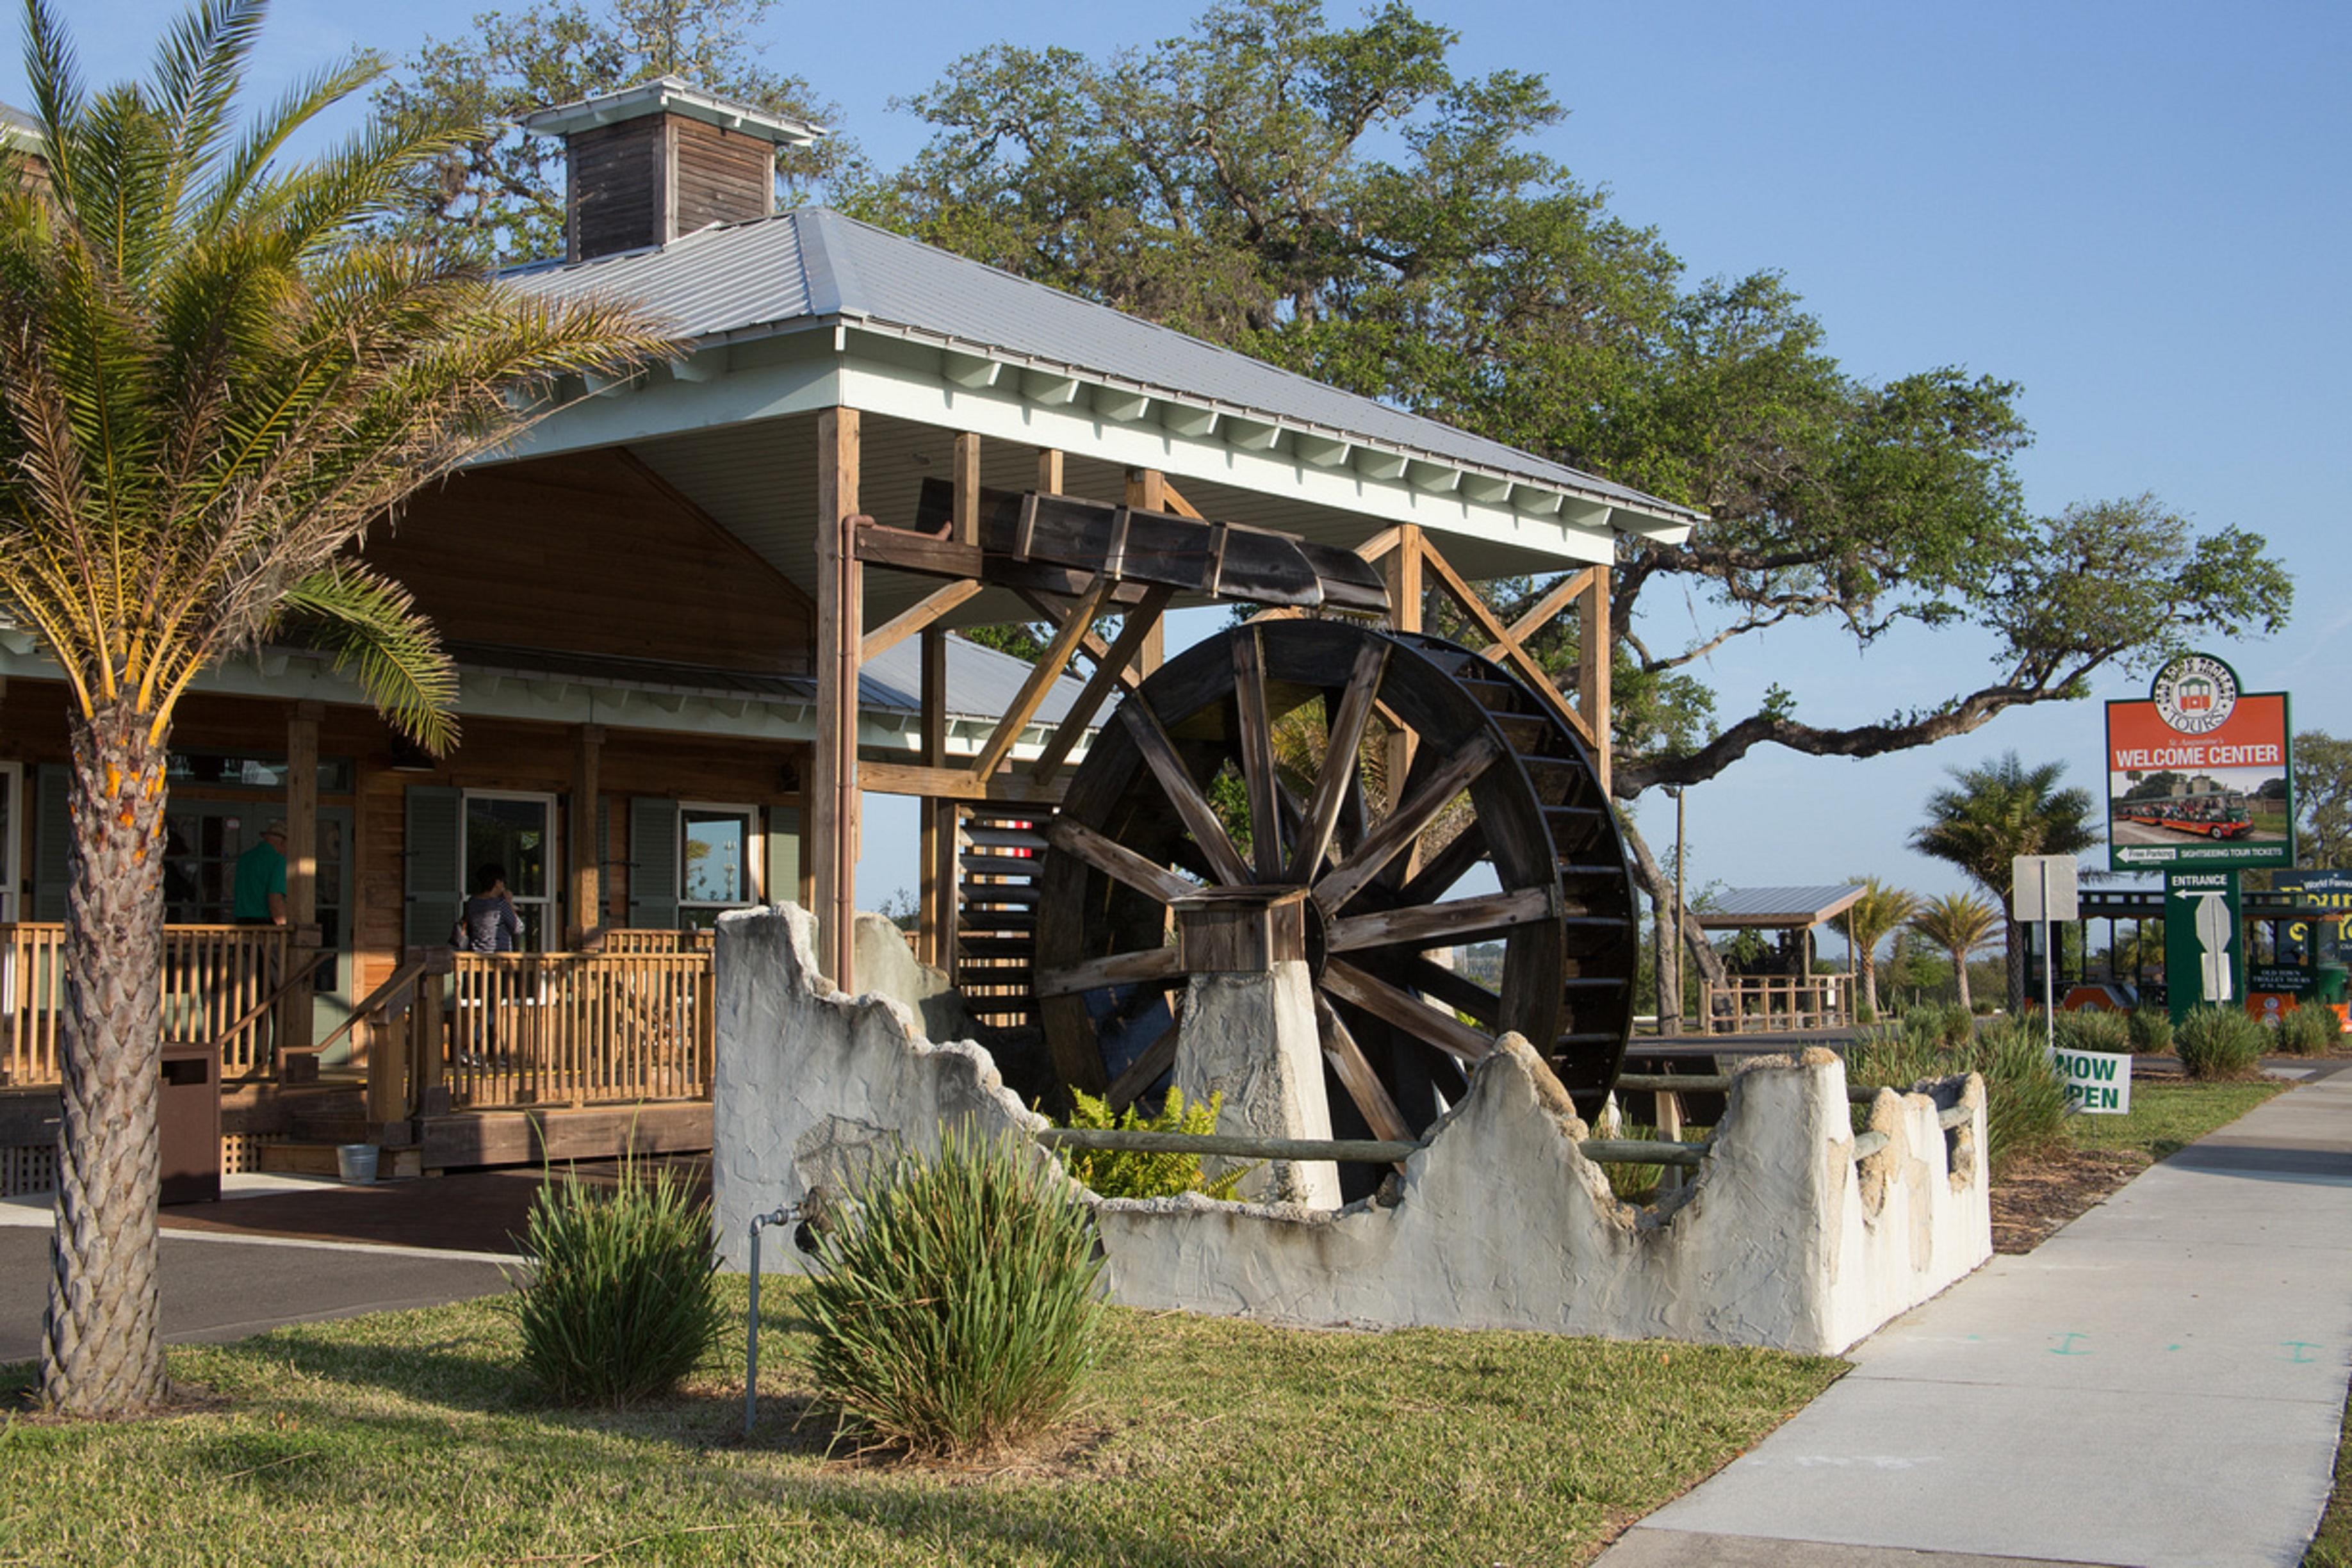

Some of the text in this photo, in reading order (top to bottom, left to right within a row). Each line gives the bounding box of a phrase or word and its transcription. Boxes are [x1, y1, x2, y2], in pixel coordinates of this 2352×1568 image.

[2169, 708, 2226, 733] TOURS
[2116, 744, 2279, 767] WELCOME CENTER
[2129, 849, 2174, 860] Free Parking
[2181, 847, 2283, 858] SIGHTSEEING TOUR TICKETS
[2171, 874, 2227, 886] ENTRANCE
[2304, 879, 2327, 889] World
[2055, 1055, 2117, 1081] NOW
[2064, 1084, 2119, 1109] PEN
